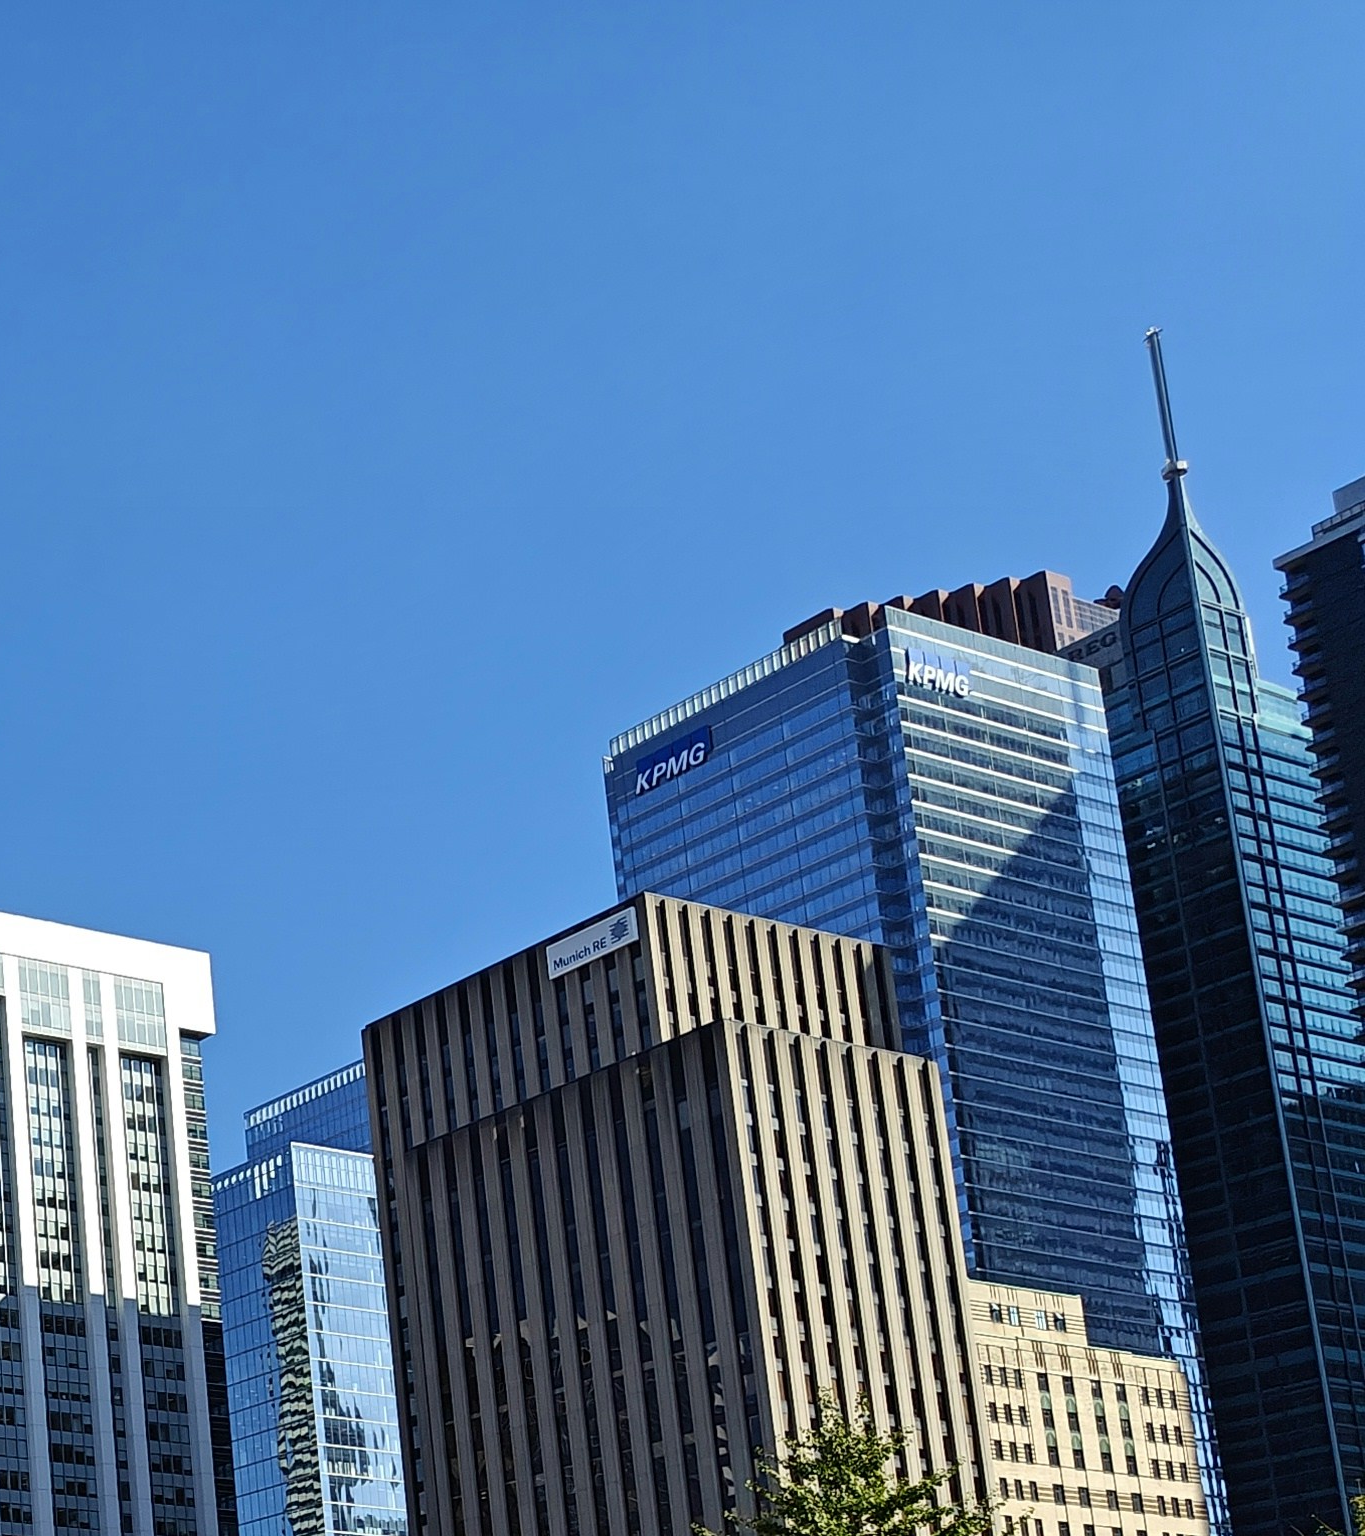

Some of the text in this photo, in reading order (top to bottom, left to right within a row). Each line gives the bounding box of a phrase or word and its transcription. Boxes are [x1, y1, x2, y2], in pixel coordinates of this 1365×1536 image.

[907, 660, 970, 697] KPMG
[635, 742, 706, 796] KPMG
[553, 936, 608, 971] Munich RE
